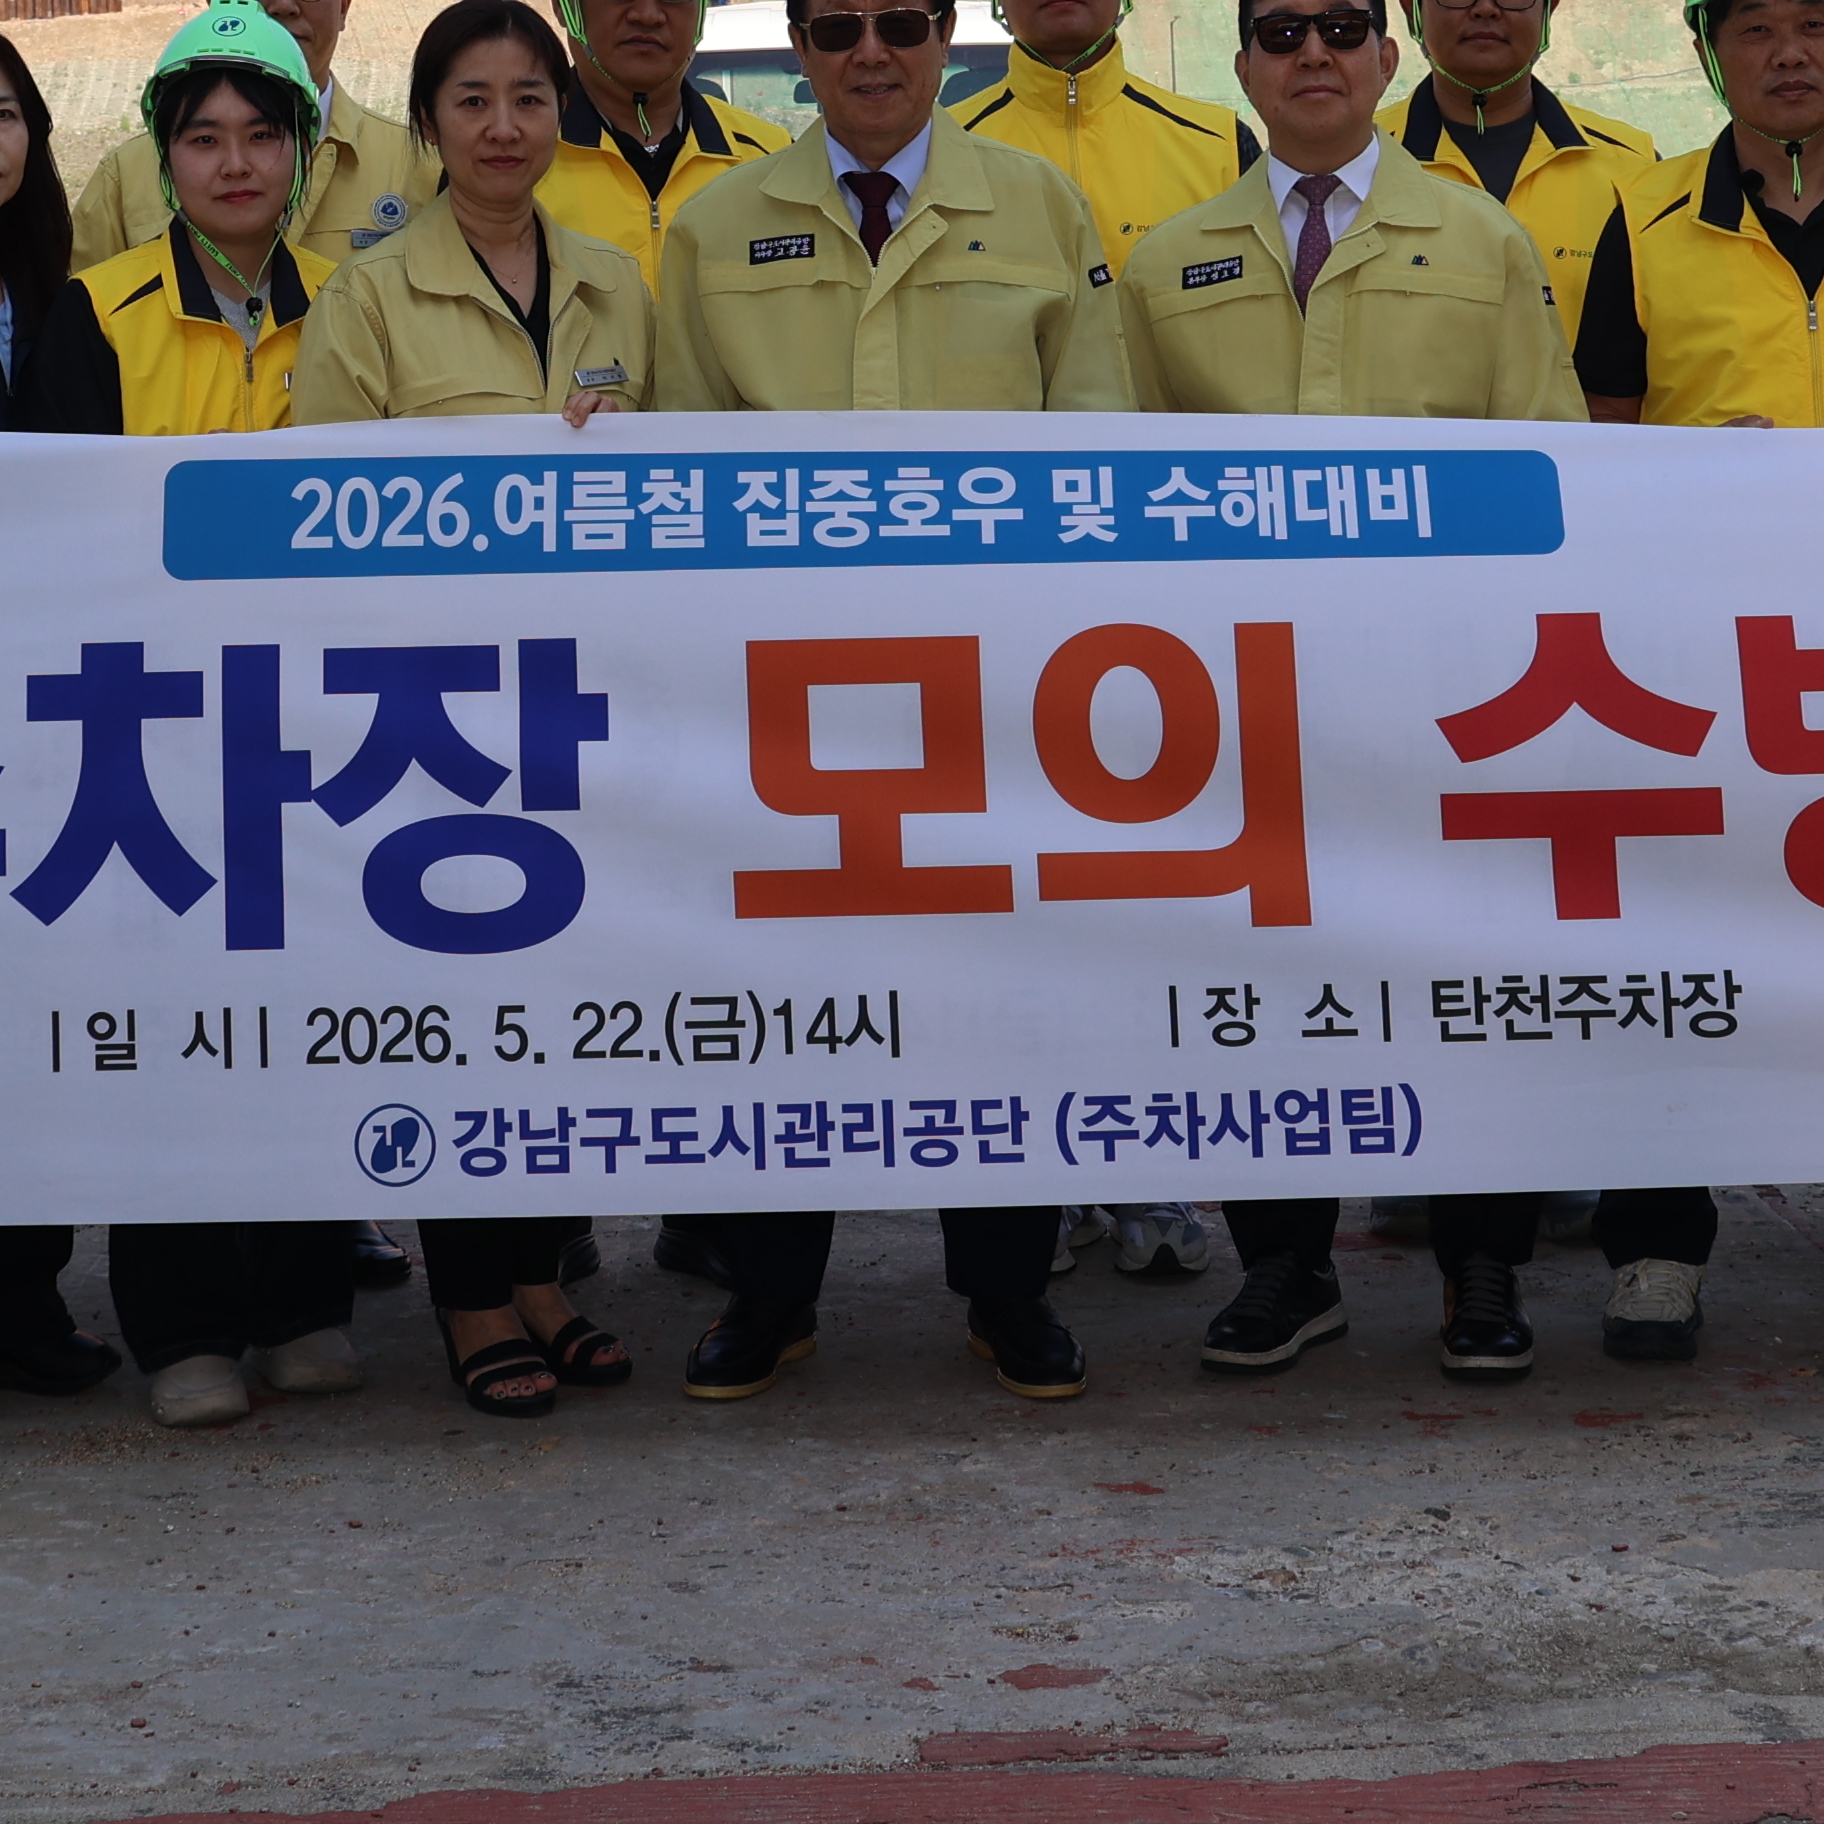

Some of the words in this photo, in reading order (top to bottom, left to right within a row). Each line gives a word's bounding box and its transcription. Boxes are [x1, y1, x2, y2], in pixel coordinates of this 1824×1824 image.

[292, 470, 705, 551] 2026.여름철
[732, 467, 1023, 547] 집중호우
[1052, 467, 1117, 543] 및
[1144, 465, 1432, 540] 수해대비
[735, 622, 1311, 927] 모의
[306, 1004, 467, 1066] 2026.
[494, 1004, 546, 1065] 5.
[1431, 969, 1743, 1043] 탄천주차장
[451, 1095, 1030, 1178] 강남구도시관리공단
[1056, 1083, 1422, 1165] (주차사업팀)
